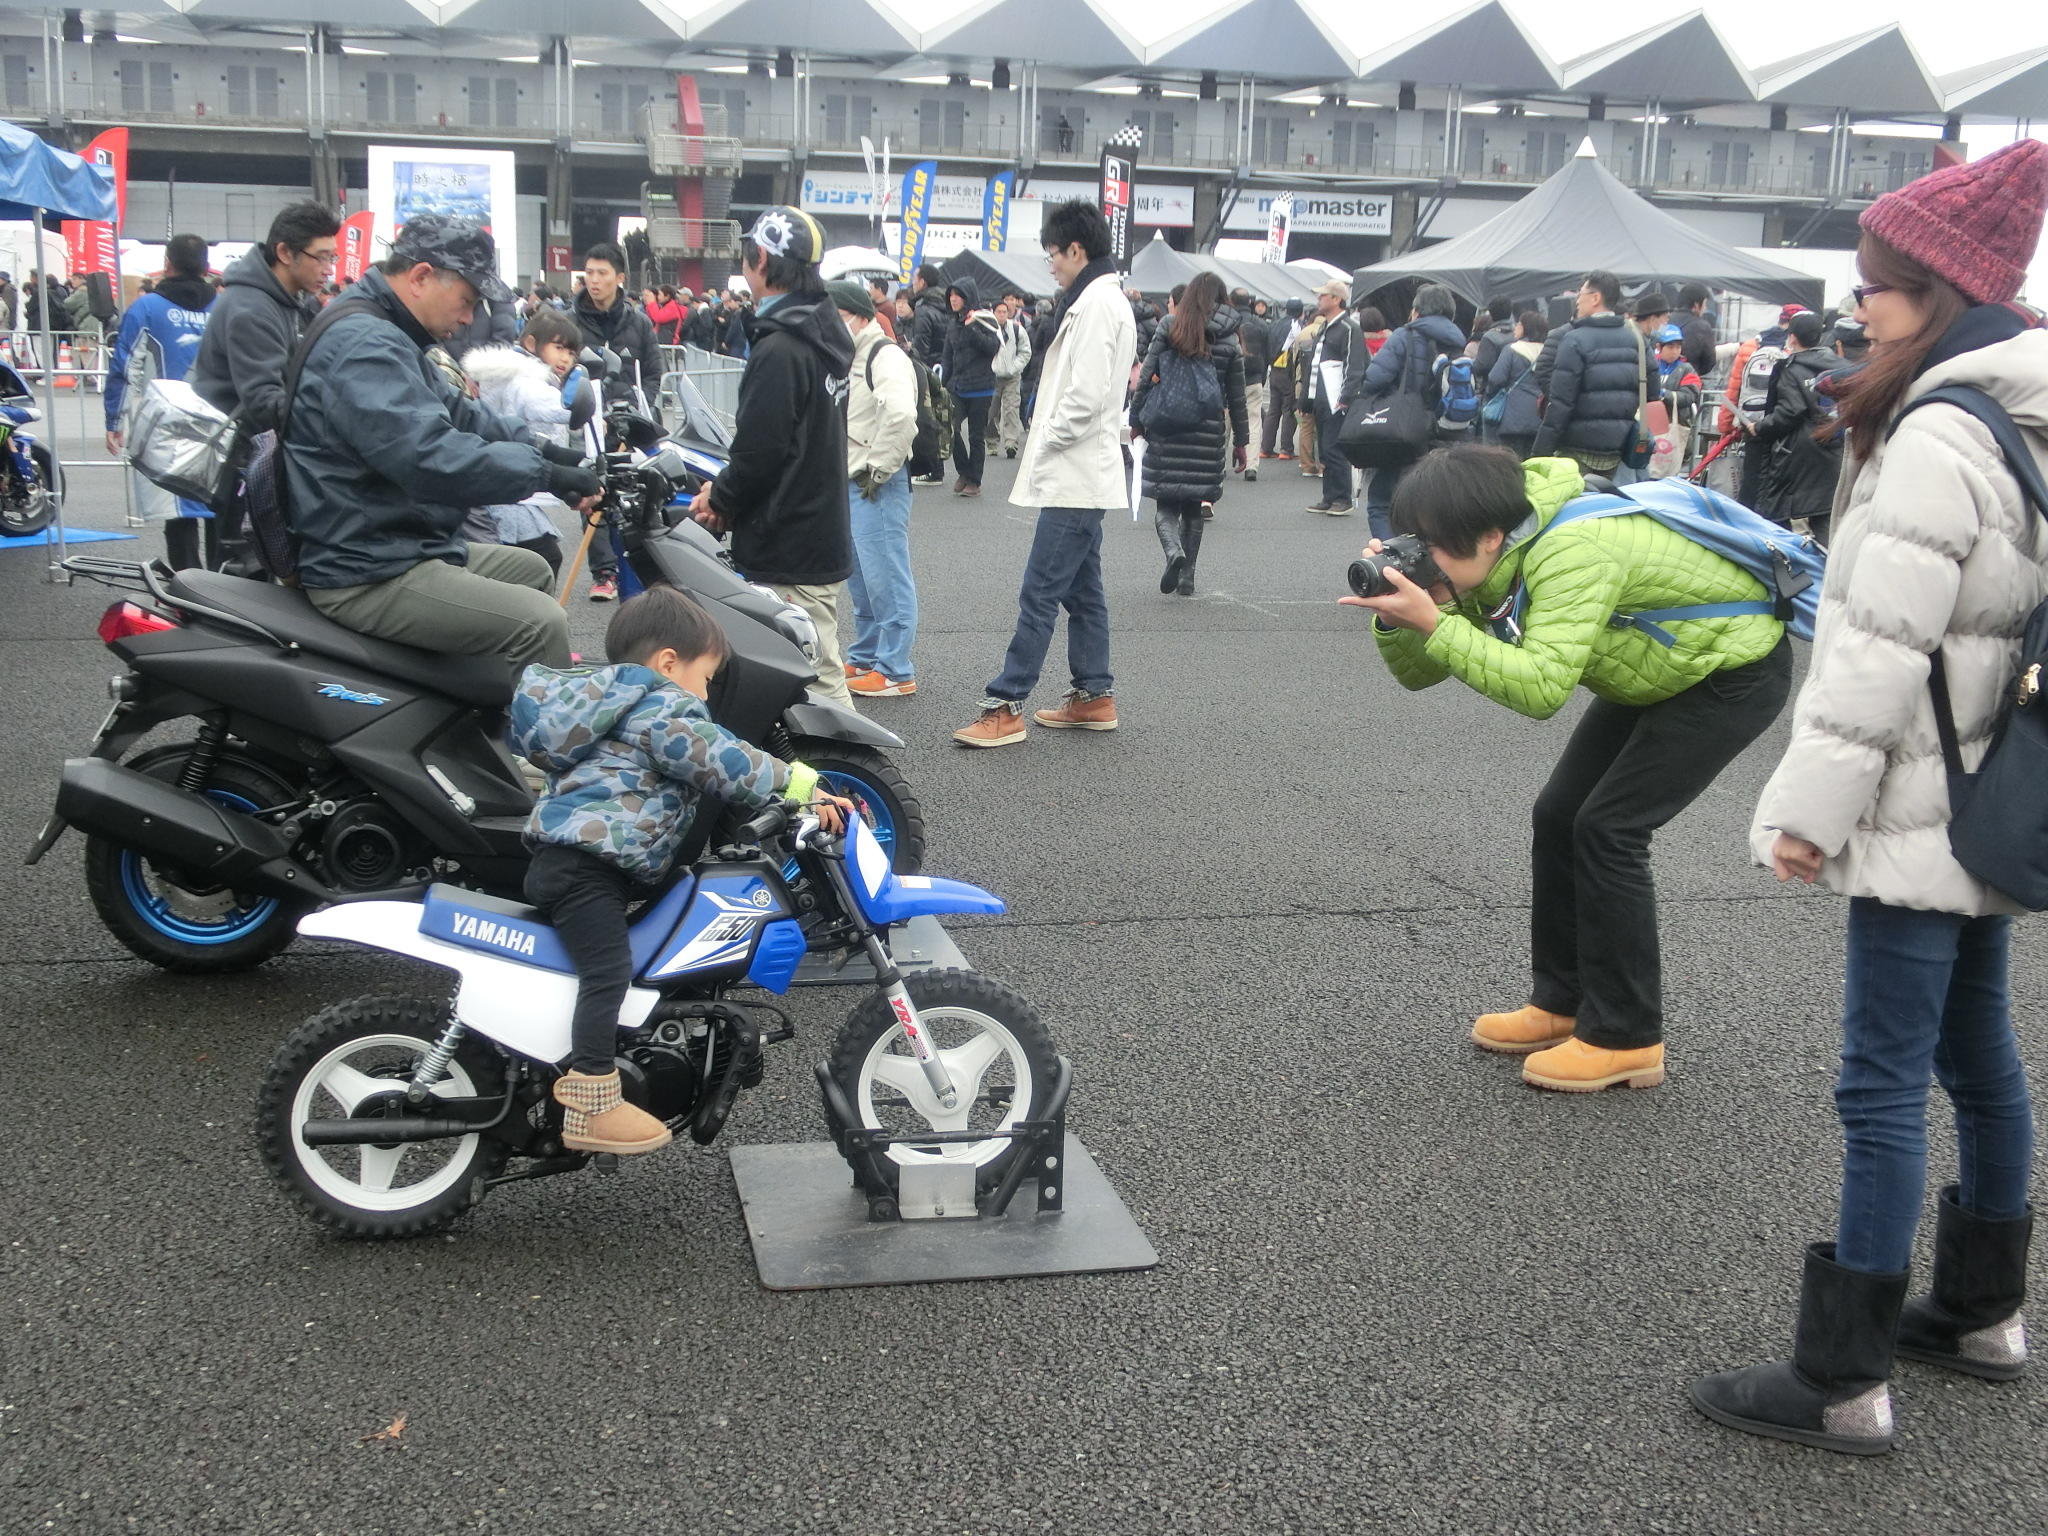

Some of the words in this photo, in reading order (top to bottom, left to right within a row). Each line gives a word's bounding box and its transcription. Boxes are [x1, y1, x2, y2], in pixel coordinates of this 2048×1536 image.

[95, 150, 107, 165] G
[1106, 158, 1121, 202] GR
[899, 169, 928, 284] GOODYEAR
[988, 180, 1006, 251] DYEAR
[1258, 197, 1387, 218] mpmaster
[1291, 218, 1331, 227] APMASTER
[1118, 208, 1128, 260] TOYOTA
[555, 254, 567, 271] L
[452, 912, 536, 956] YAMAHA
